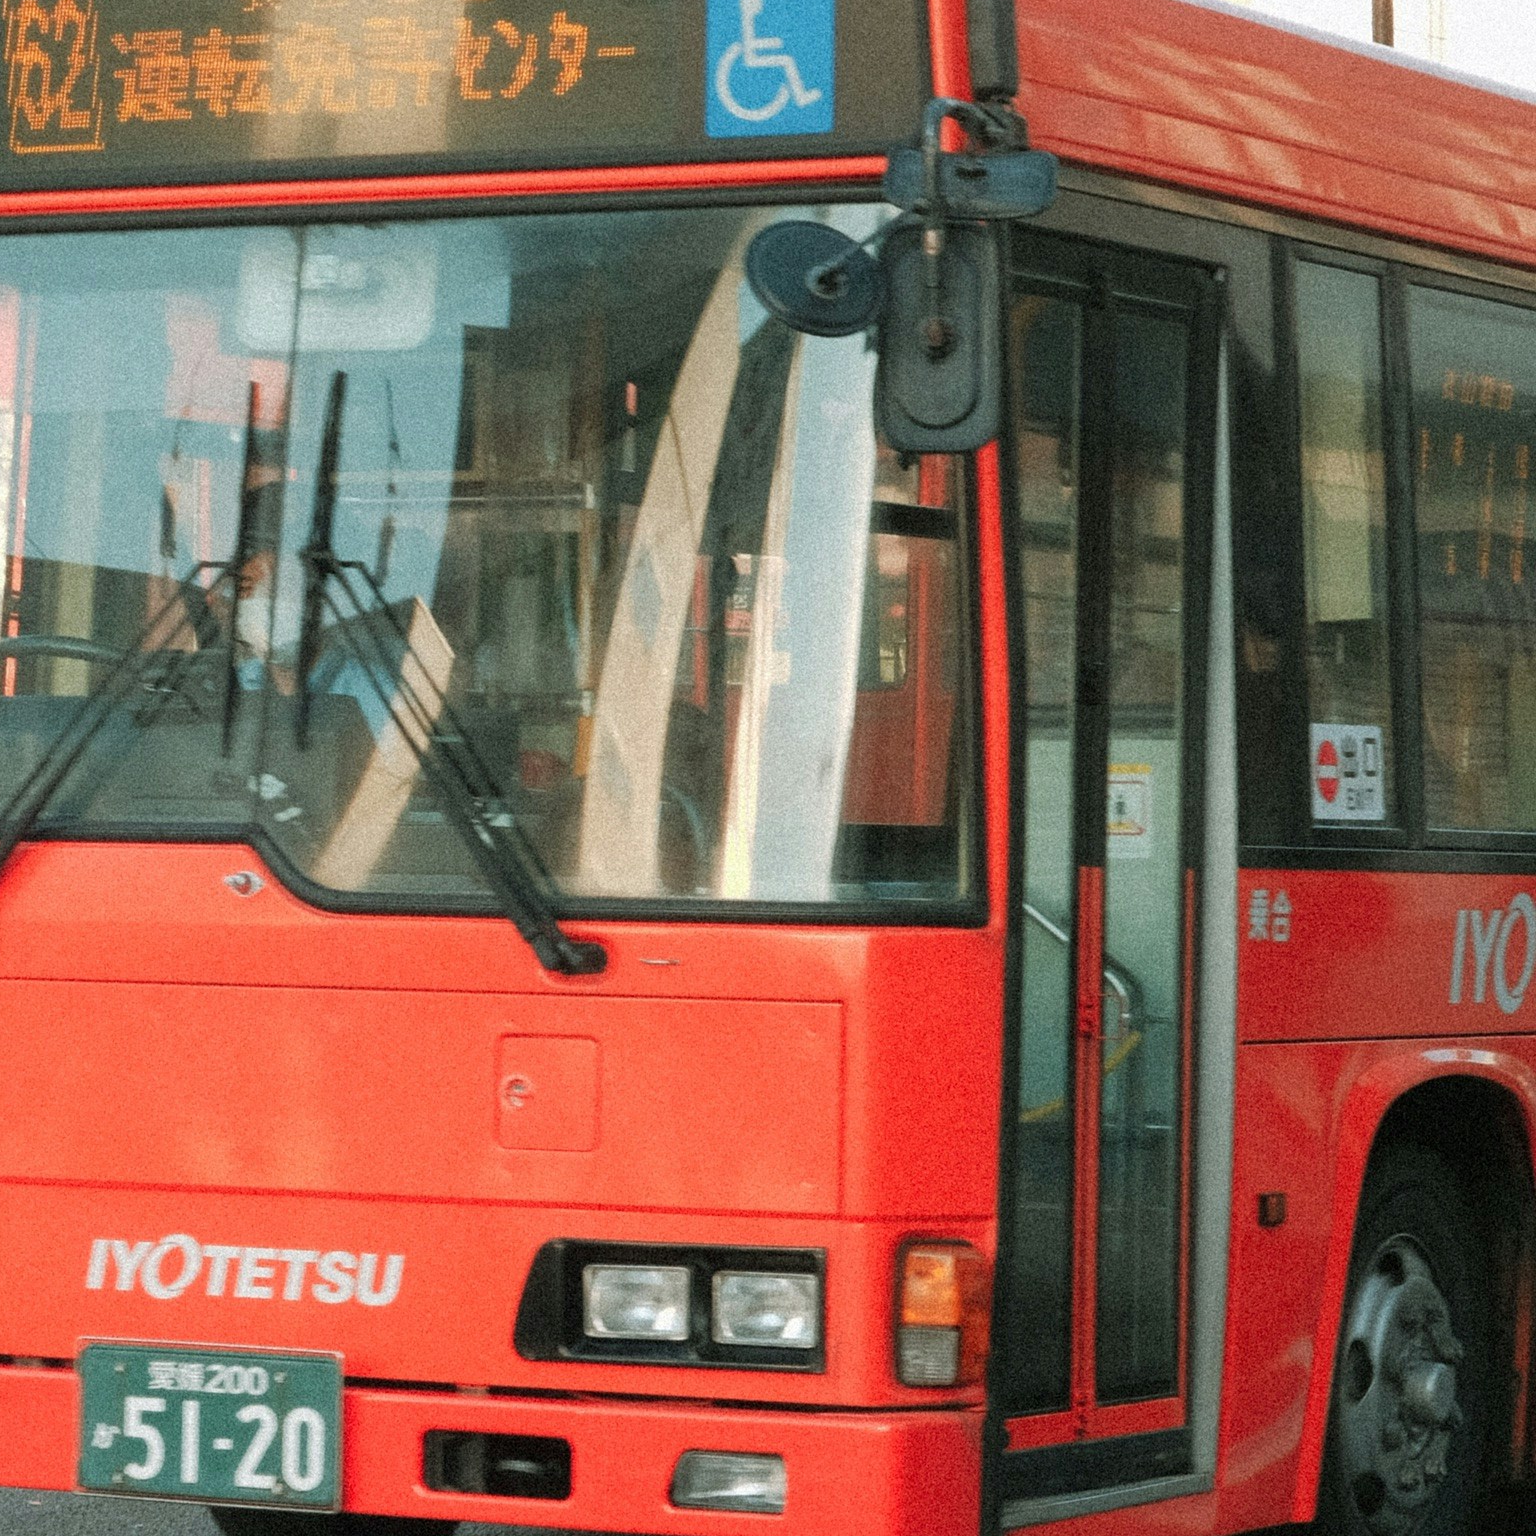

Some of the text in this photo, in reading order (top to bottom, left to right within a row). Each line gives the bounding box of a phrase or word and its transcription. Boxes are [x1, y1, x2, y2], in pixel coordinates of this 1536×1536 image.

[112, 10, 636, 125] 運転免許センター
[85, 1233, 405, 1307] IYOTETSU
[123, 1395, 327, 1493] 51-20
